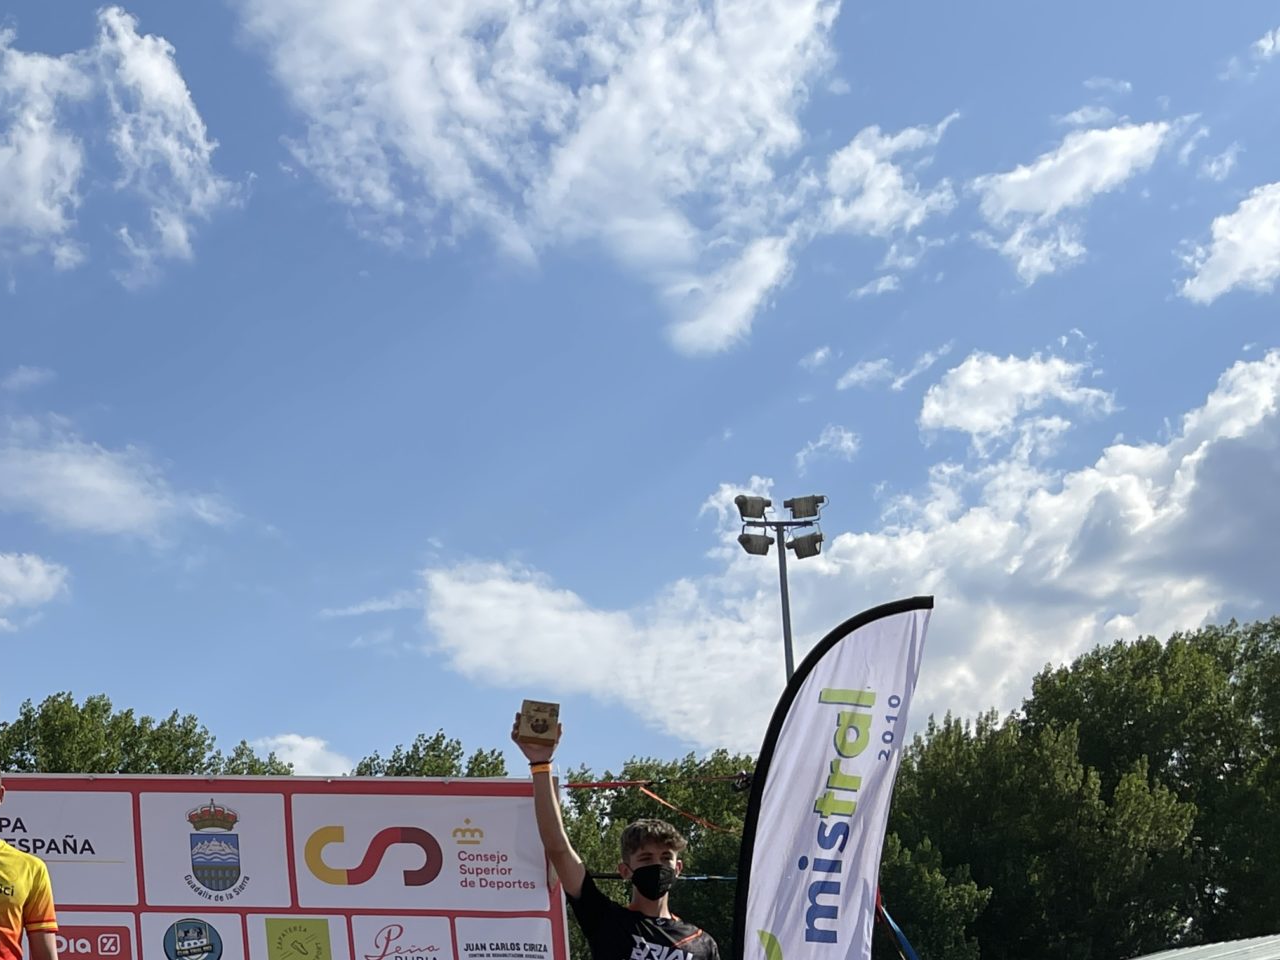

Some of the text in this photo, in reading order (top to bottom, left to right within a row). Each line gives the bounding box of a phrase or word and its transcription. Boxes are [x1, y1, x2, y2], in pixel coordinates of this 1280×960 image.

[878, 694, 902, 762] 2010
[798, 688, 877, 943] mistral
[457, 850, 508, 864] Consejo
[459, 864, 513, 878] Superior
[184, 873, 213, 901] Guadalix
[214, 894, 224, 902] de
[233, 875, 251, 896] Sierra
[460, 878, 536, 890] de Deportes
[463, 942, 548, 953] JUAN CARLOS CIRIZA
